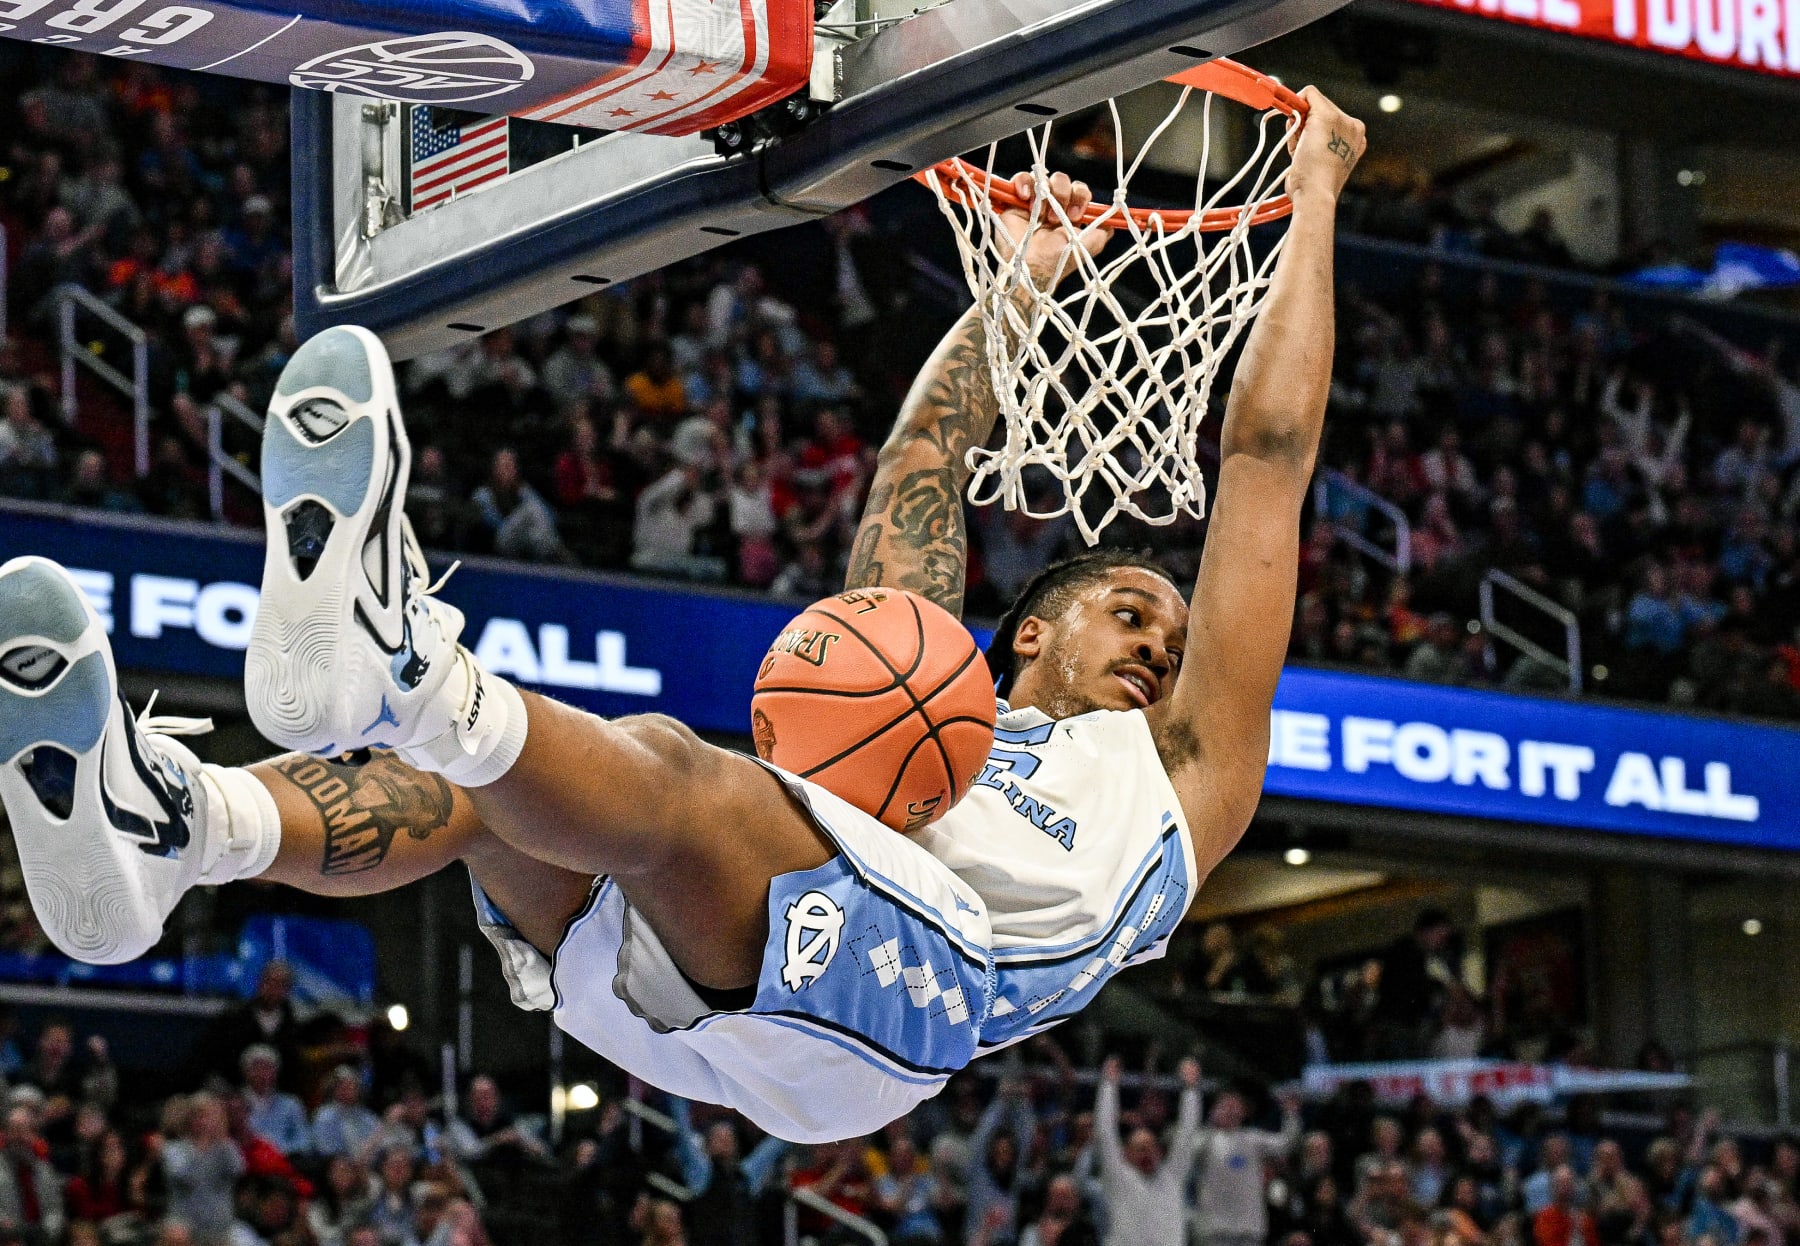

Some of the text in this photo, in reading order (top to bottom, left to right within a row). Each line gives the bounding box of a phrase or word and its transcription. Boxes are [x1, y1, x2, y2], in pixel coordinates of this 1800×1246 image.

[474, 616, 662, 698] ALL
[973, 763, 1078, 853] LINA
[1341, 714, 1512, 791] FOR
[1517, 738, 1596, 802] IT
[1602, 751, 1760, 823] ALL
